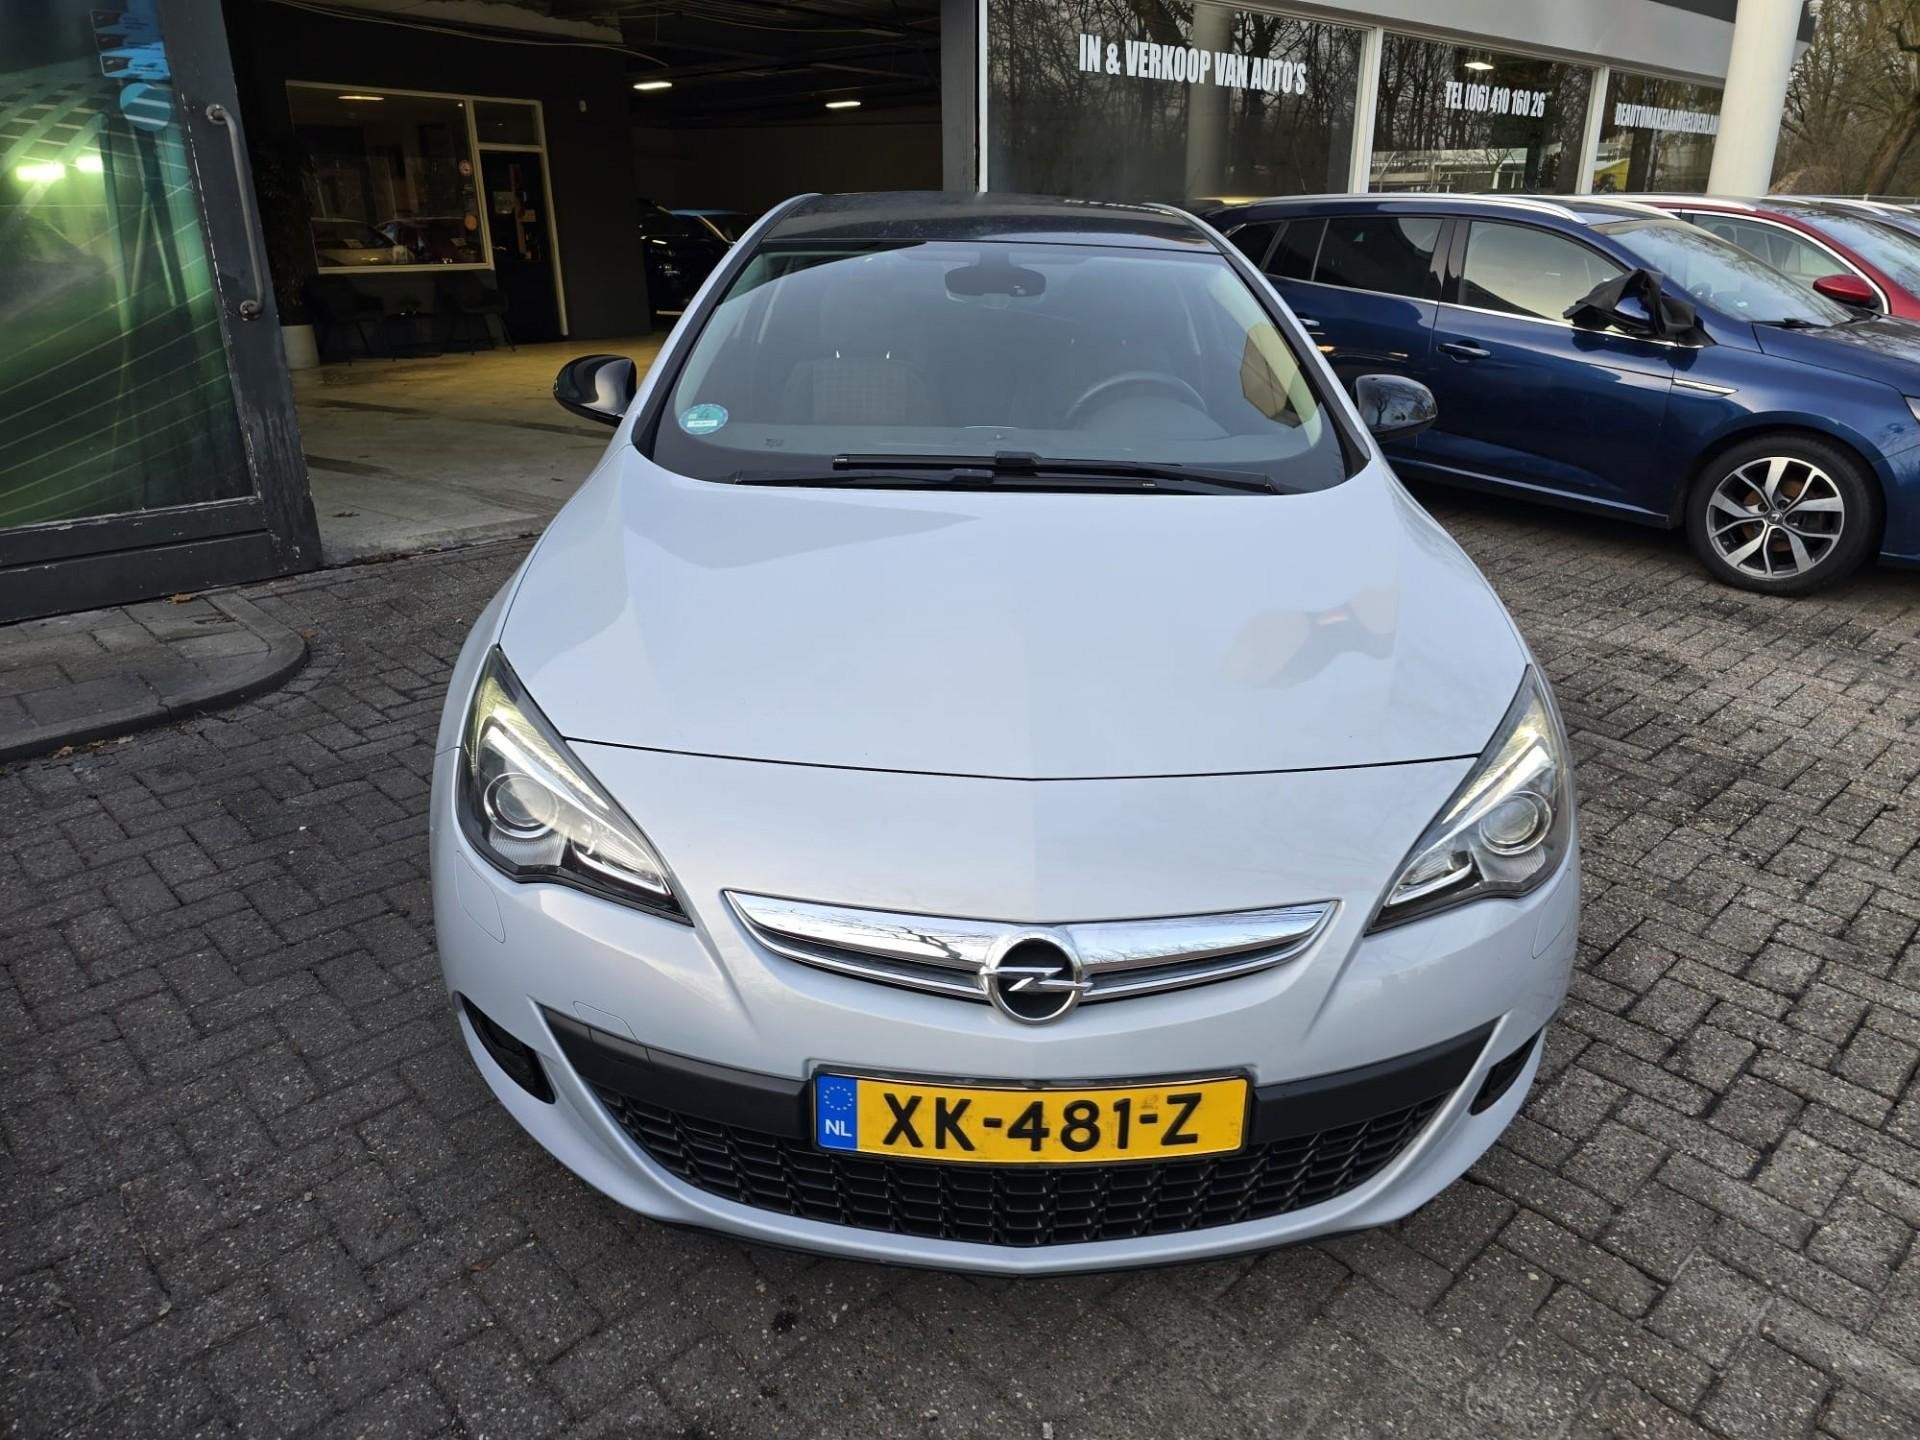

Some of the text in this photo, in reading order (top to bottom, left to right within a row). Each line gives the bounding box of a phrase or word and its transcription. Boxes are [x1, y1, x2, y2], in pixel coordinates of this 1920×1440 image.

[1079, 33, 1307, 95] IN & VERKOOP VAN AUTO'S
[1445, 81, 1463, 110] TEL
[1490, 86, 1510, 114] 410
[1511, 89, 1530, 116] 160
[1530, 91, 1546, 118] 26
[825, 1119, 853, 1138] NL
[882, 1092, 1202, 1152] XK-481-Z
